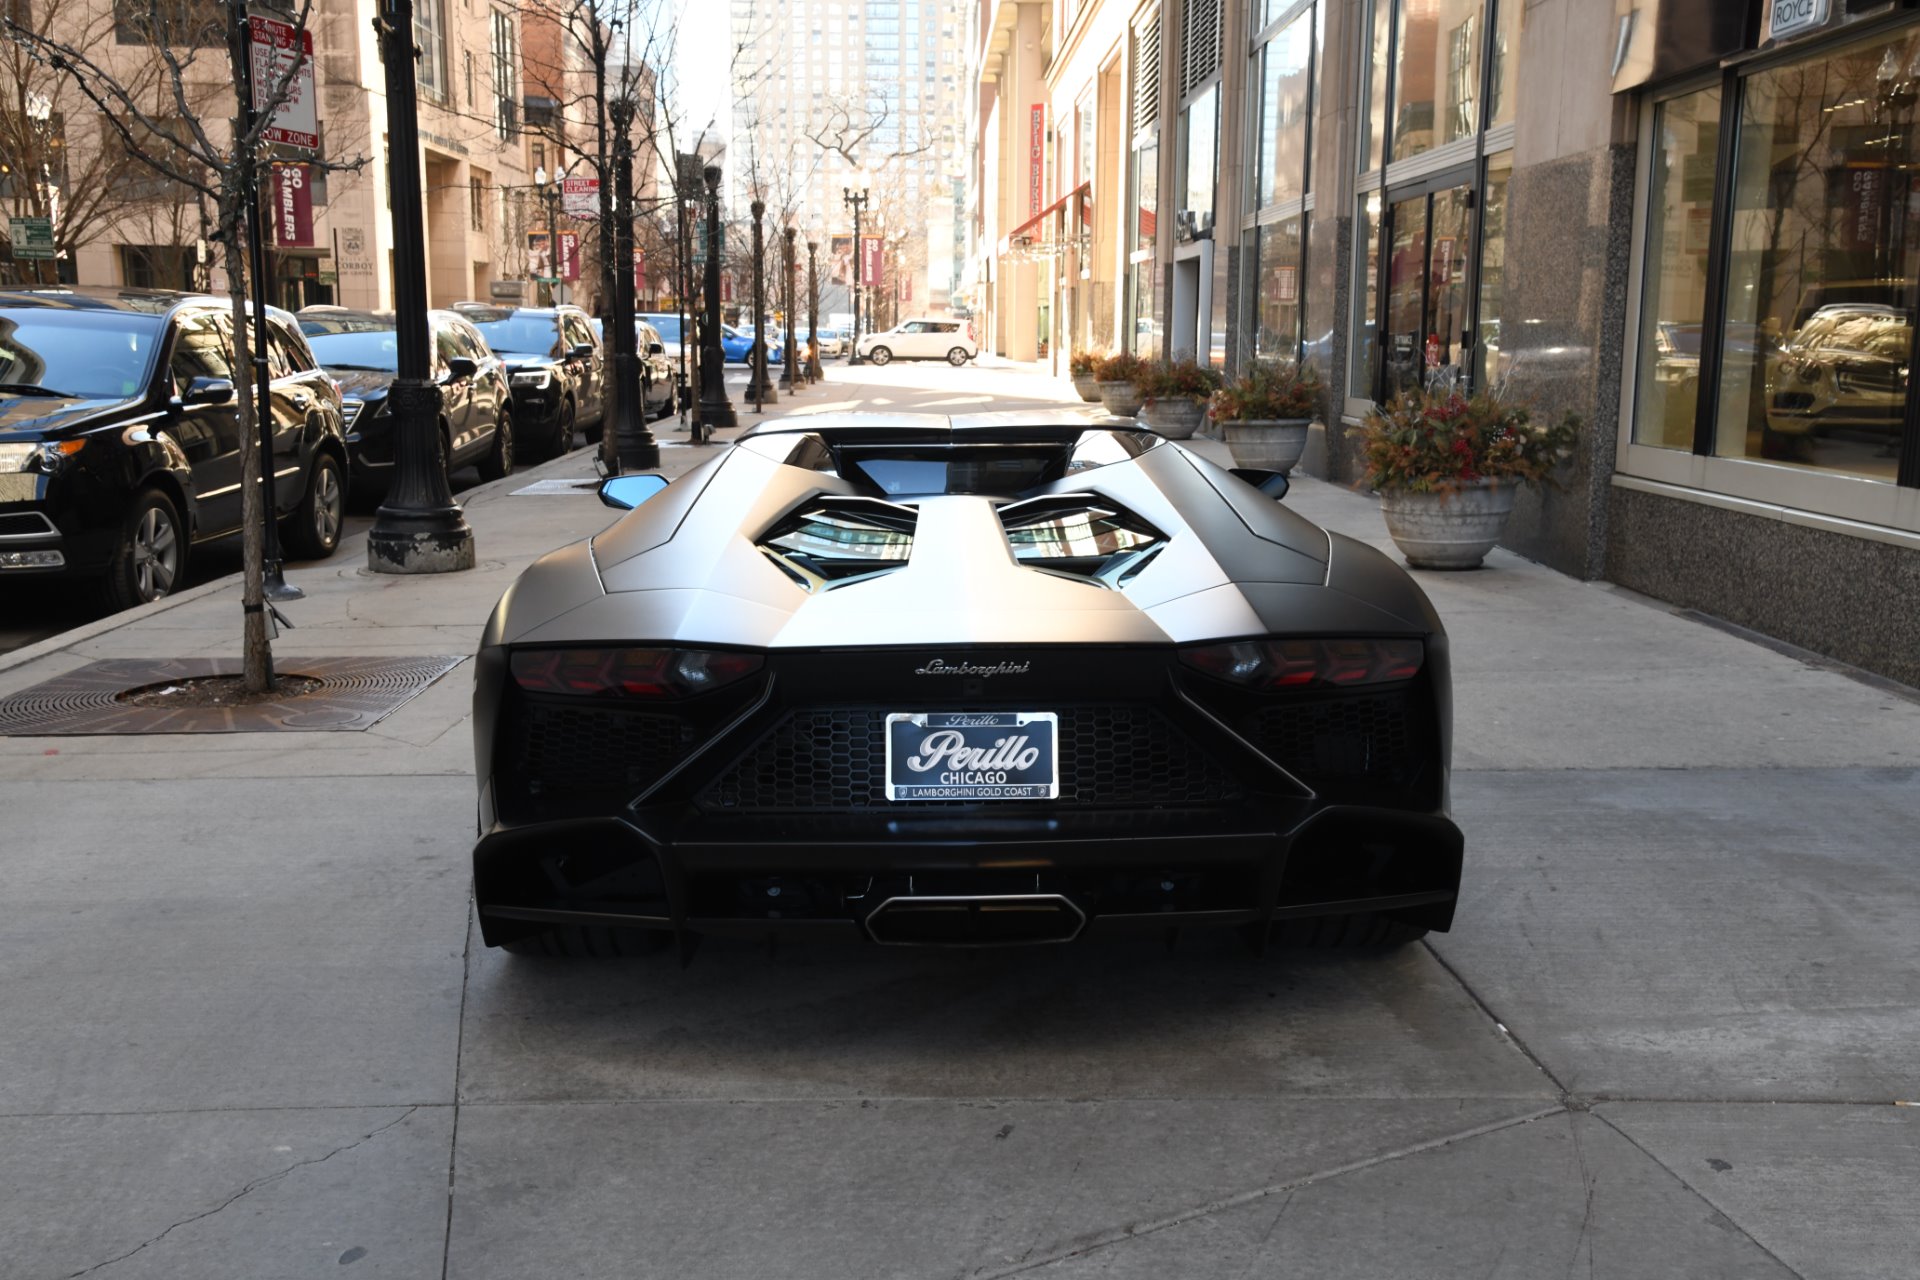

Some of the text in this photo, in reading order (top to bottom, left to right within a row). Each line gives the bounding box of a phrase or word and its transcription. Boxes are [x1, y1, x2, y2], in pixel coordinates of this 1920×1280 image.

[1775, 0, 1813, 26] ROYCE
[253, 30, 306, 52] STANING ZOE
[255, 47, 269, 58] USE
[255, 57, 290, 74] FLAHING
[287, 131, 314, 146] ZONE
[1031, 109, 1041, 159] EPIC
[291, 168, 302, 188] GO
[282, 168, 296, 241] RAMBLERS
[915, 659, 1030, 678] Lamborghini
[945, 714, 999, 726] Perillo
[907, 730, 1040, 773] Perillo
[940, 772, 1007, 785] CHICAGO
[912, 786, 1032, 797] LAMBORGHINI GOLD COAST
